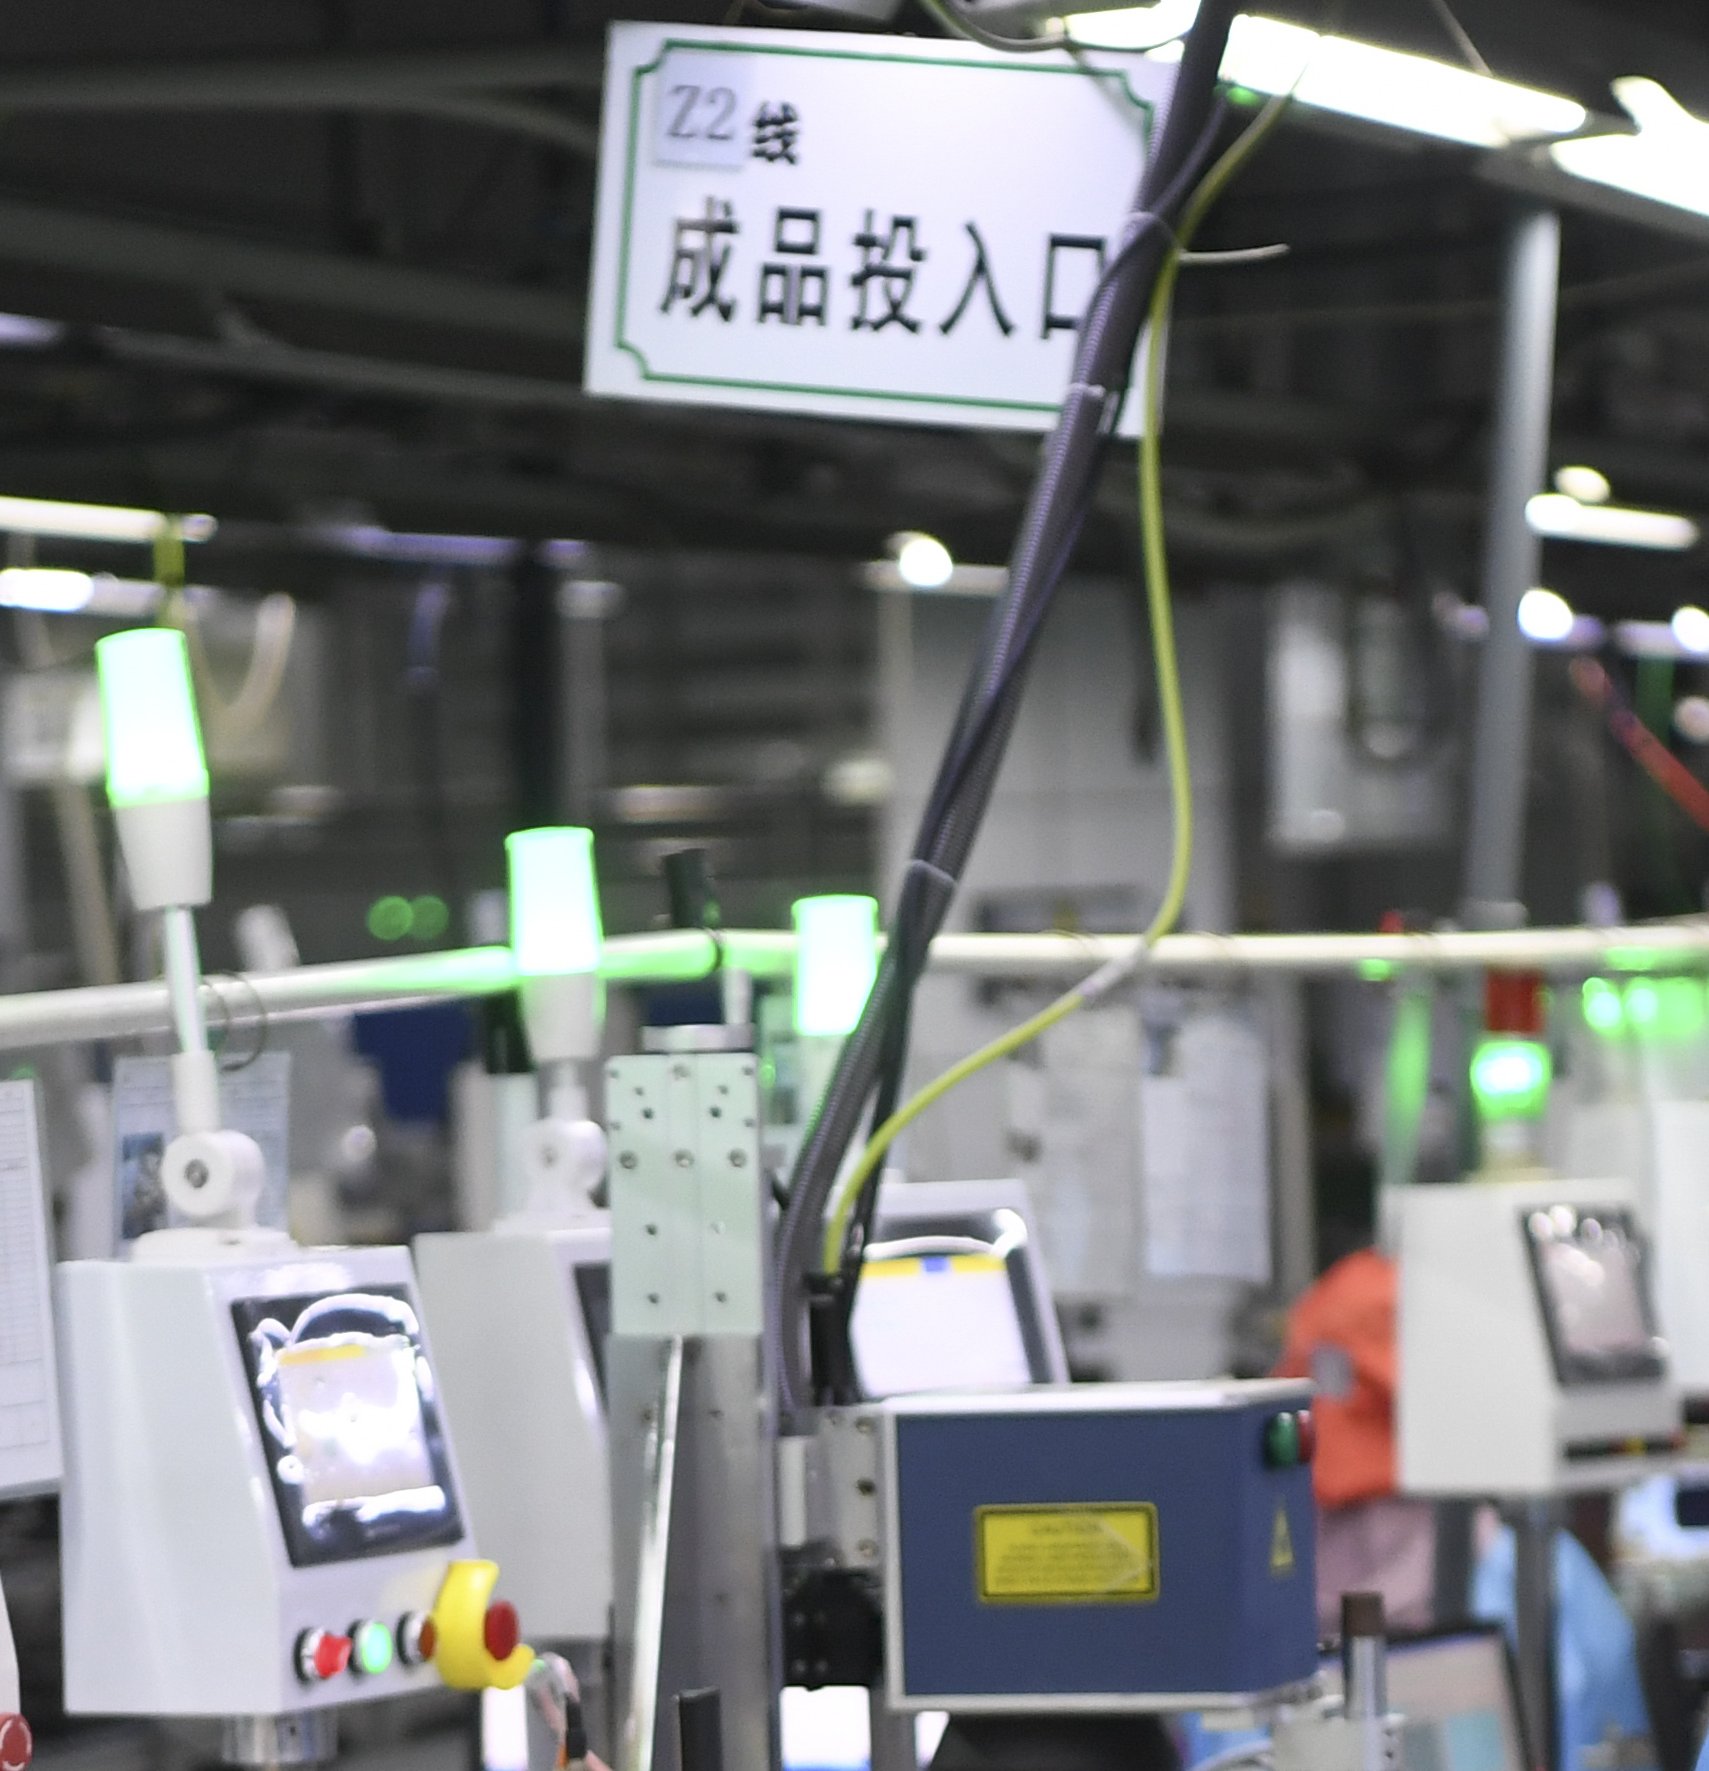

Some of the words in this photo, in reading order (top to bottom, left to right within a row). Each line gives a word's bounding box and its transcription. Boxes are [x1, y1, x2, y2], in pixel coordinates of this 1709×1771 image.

[660, 197, 1109, 340] 成品投入口
